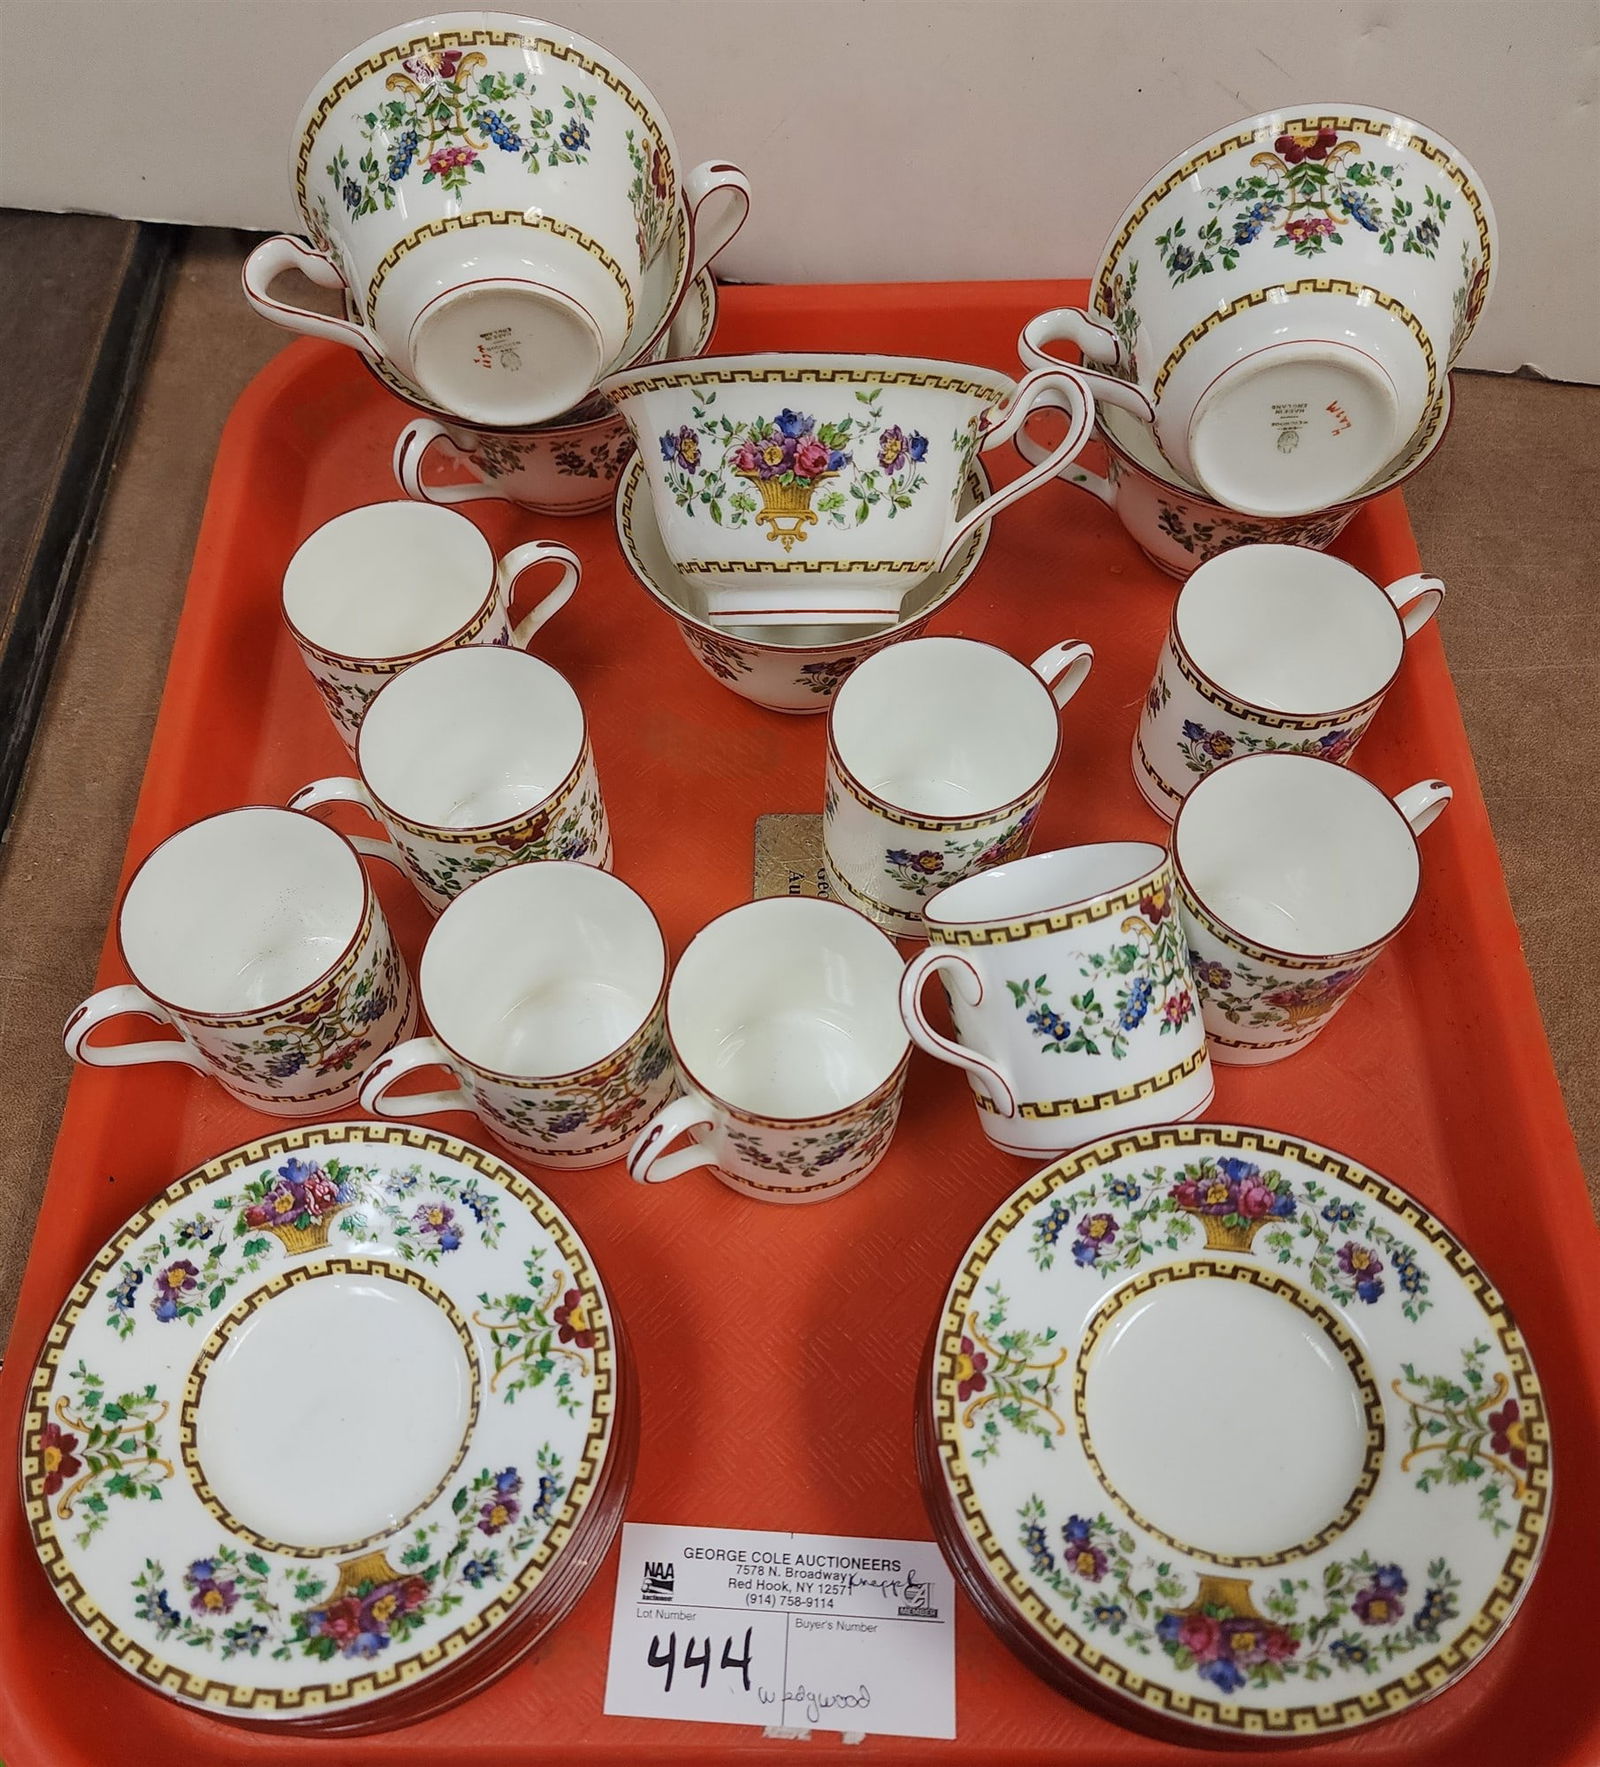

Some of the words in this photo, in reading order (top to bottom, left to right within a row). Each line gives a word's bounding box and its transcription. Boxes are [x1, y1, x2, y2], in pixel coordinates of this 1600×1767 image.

[684, 1547, 747, 1562] GEORGE
[751, 1551, 791, 1565] COLE
[795, 1554, 901, 1572] AUCTIONEERS
[644, 1561, 675, 1579] NAA
[736, 1564, 765, 1576] 7578
[768, 1566, 781, 1576] N.
[785, 1567, 847, 1583] Broadway
[728, 1578, 752, 1590] Red
[756, 1580, 792, 1593] Hook,
[796, 1582, 814, 1594] NY
[745, 1593, 777, 1608] (914)
[780, 1595, 834, 1609] 758-9114
[636, 1608, 653, 1618] Lot
[655, 1609, 697, 1621] Number
[795, 1618, 833, 1631] Buyer's
[836, 1621, 879, 1633] Number
[648, 1626, 753, 1692] 444
